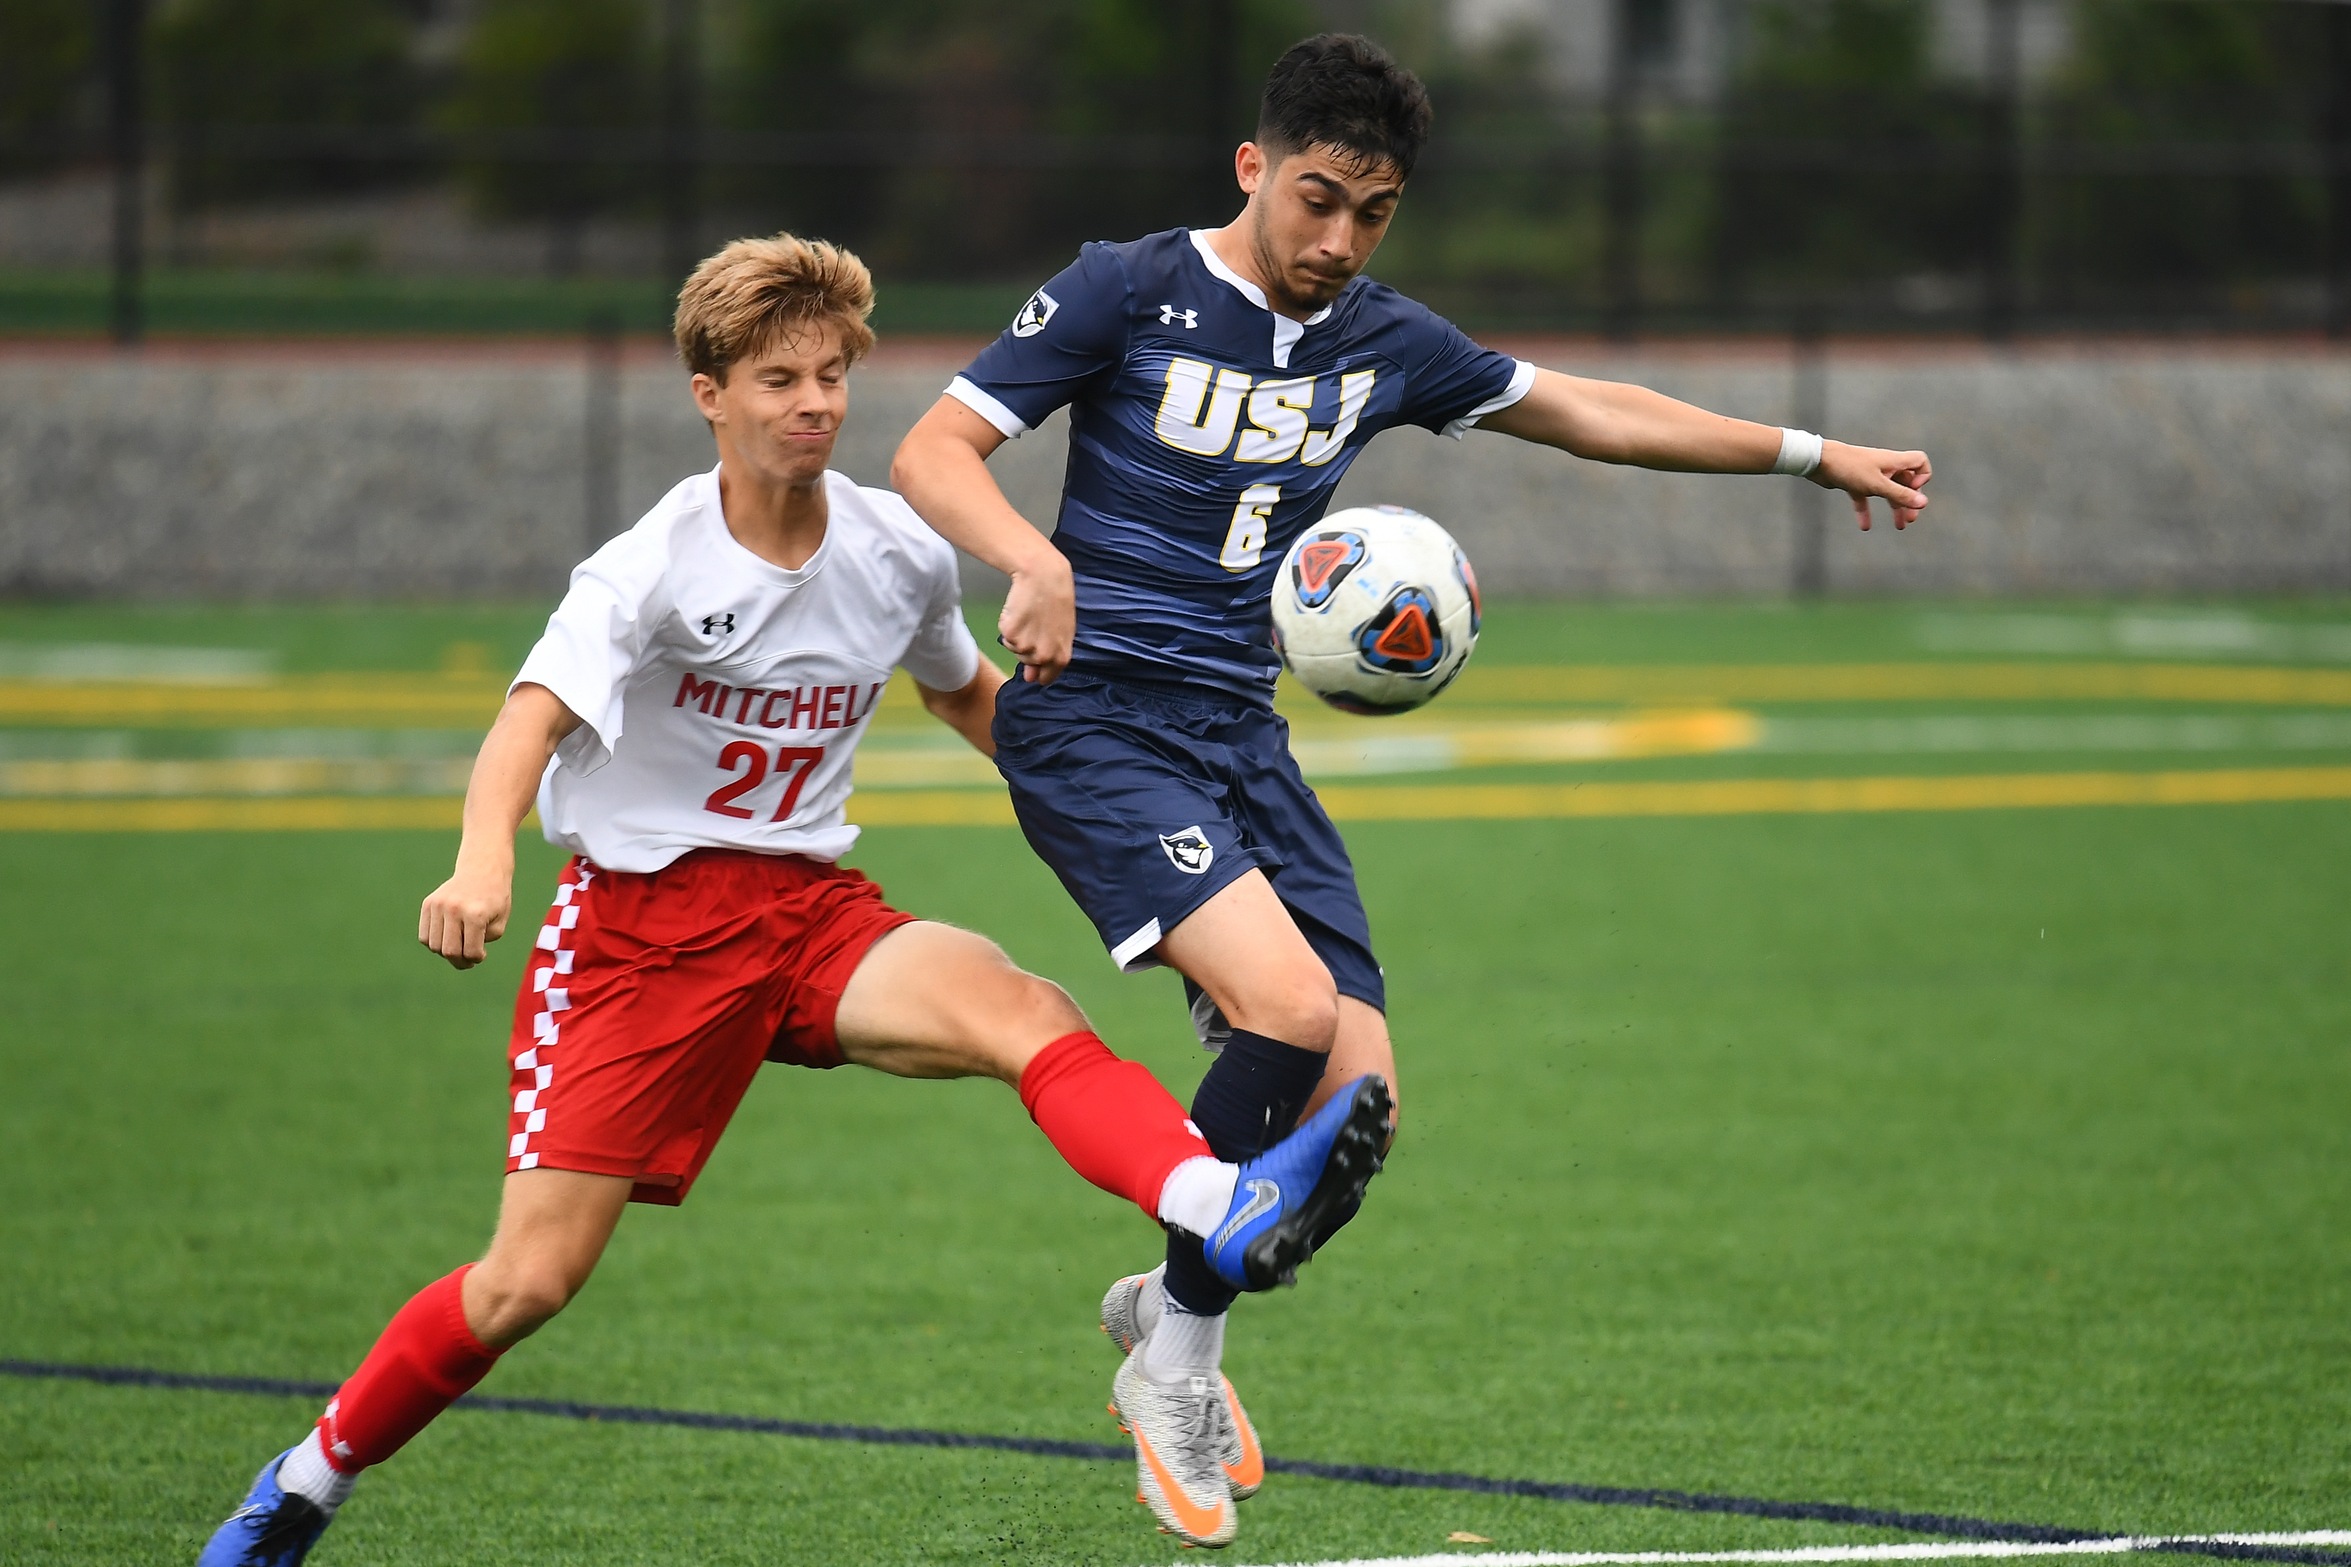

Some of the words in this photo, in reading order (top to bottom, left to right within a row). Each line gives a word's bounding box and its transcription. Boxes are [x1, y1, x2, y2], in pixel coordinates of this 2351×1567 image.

[1154, 357, 1376, 466] USJ
[1219, 484, 1281, 573] 6
[703, 740, 826, 822] 27
